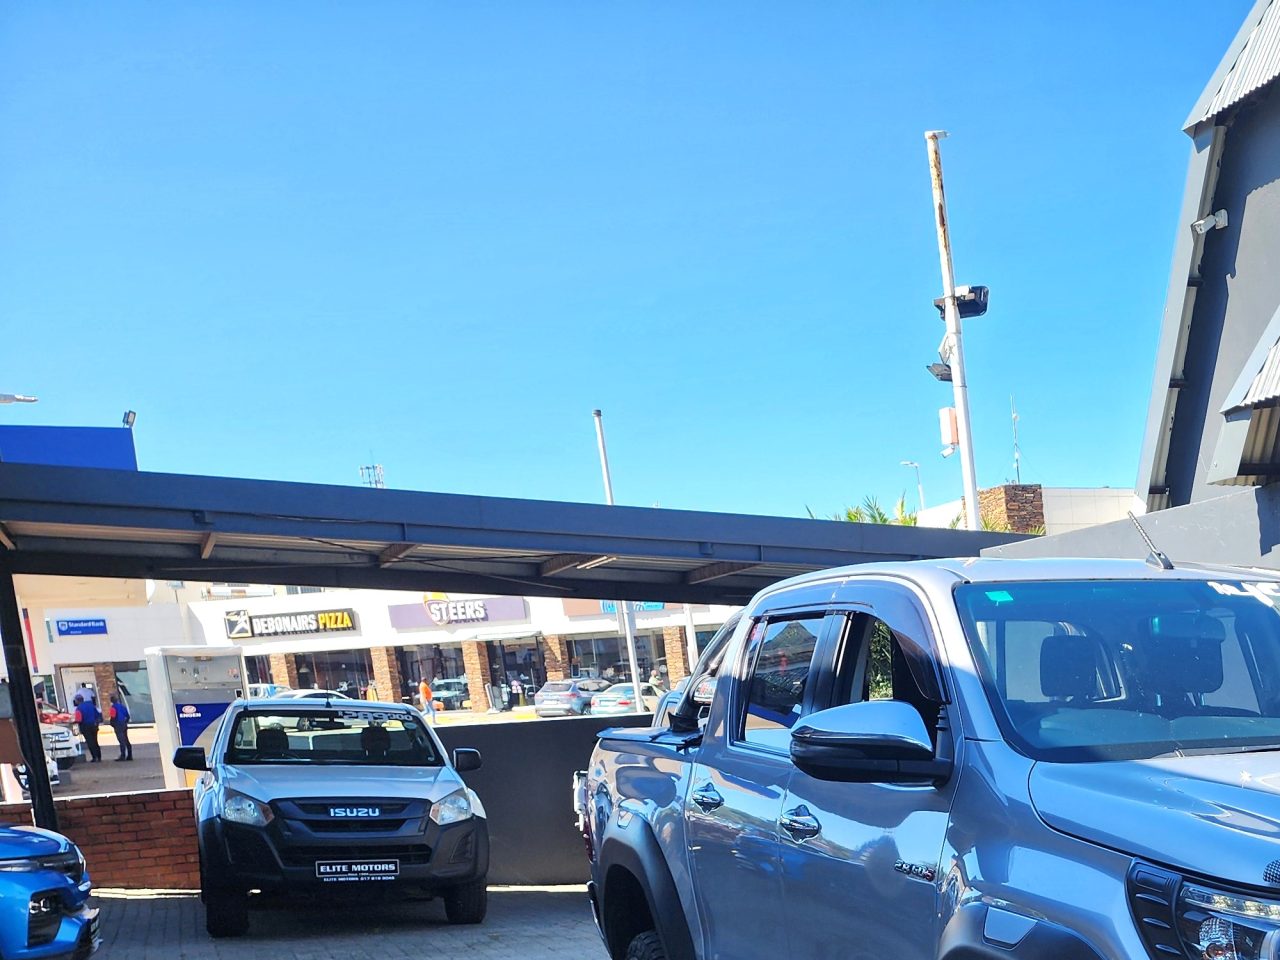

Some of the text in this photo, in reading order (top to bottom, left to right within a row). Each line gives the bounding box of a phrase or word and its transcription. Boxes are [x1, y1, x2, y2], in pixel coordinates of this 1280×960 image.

[430, 600, 486, 621] STEERS
[252, 611, 352, 634] DEBONAIRS PIZZA
[330, 808, 380, 817] ISUZU
[351, 864, 396, 872] MOTORS
